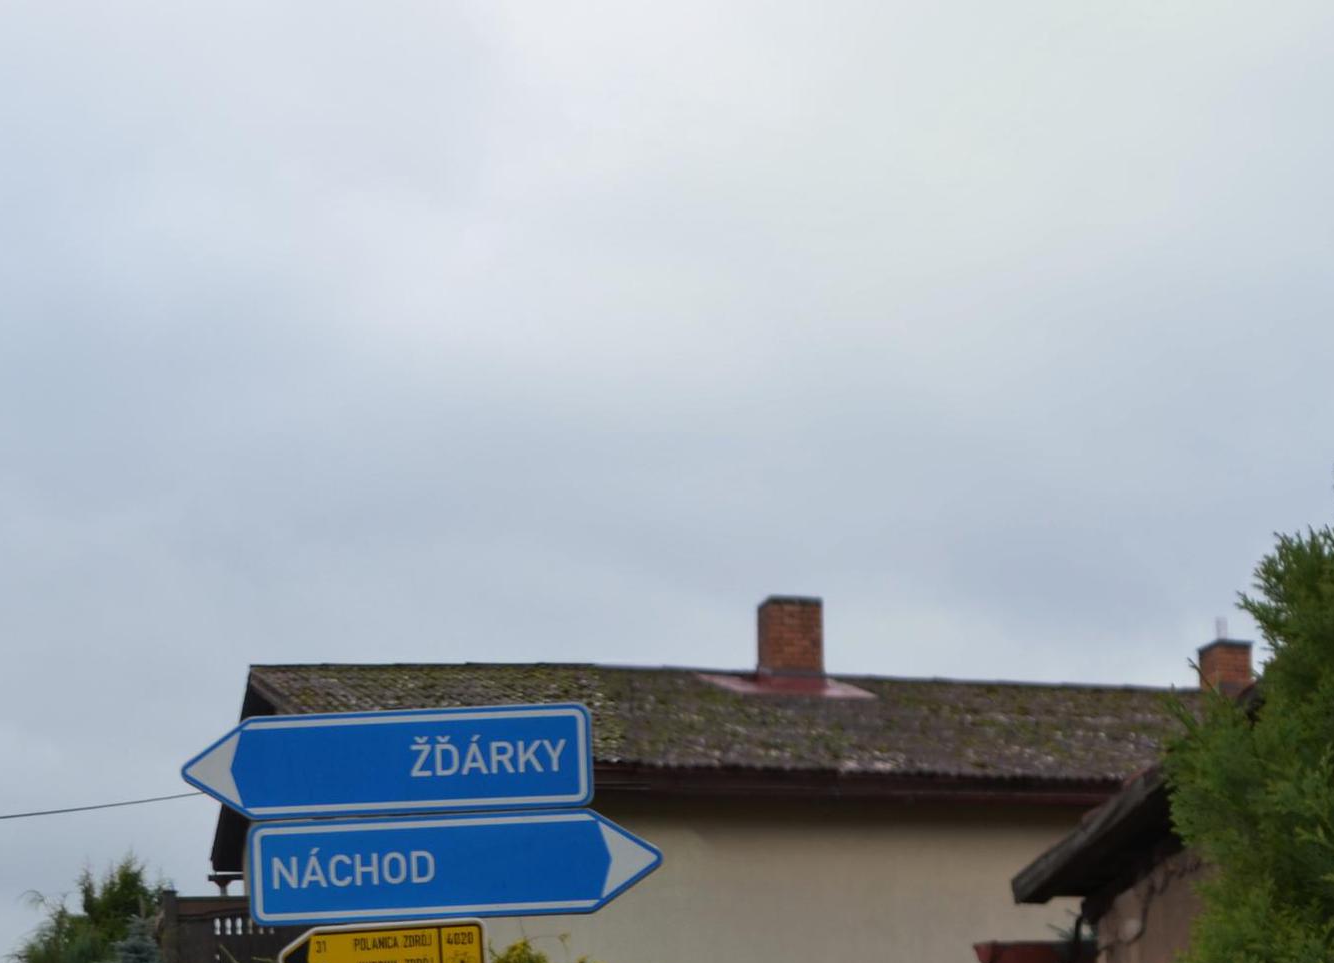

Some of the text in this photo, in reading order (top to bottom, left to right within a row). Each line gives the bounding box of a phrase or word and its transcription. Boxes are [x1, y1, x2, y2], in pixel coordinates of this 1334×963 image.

[410, 735, 567, 778] ŽĎÁRKY
[271, 848, 436, 890] NÁCHOD
[353, 935, 399, 952] POLANICA
[446, 932, 474, 945] 4020
